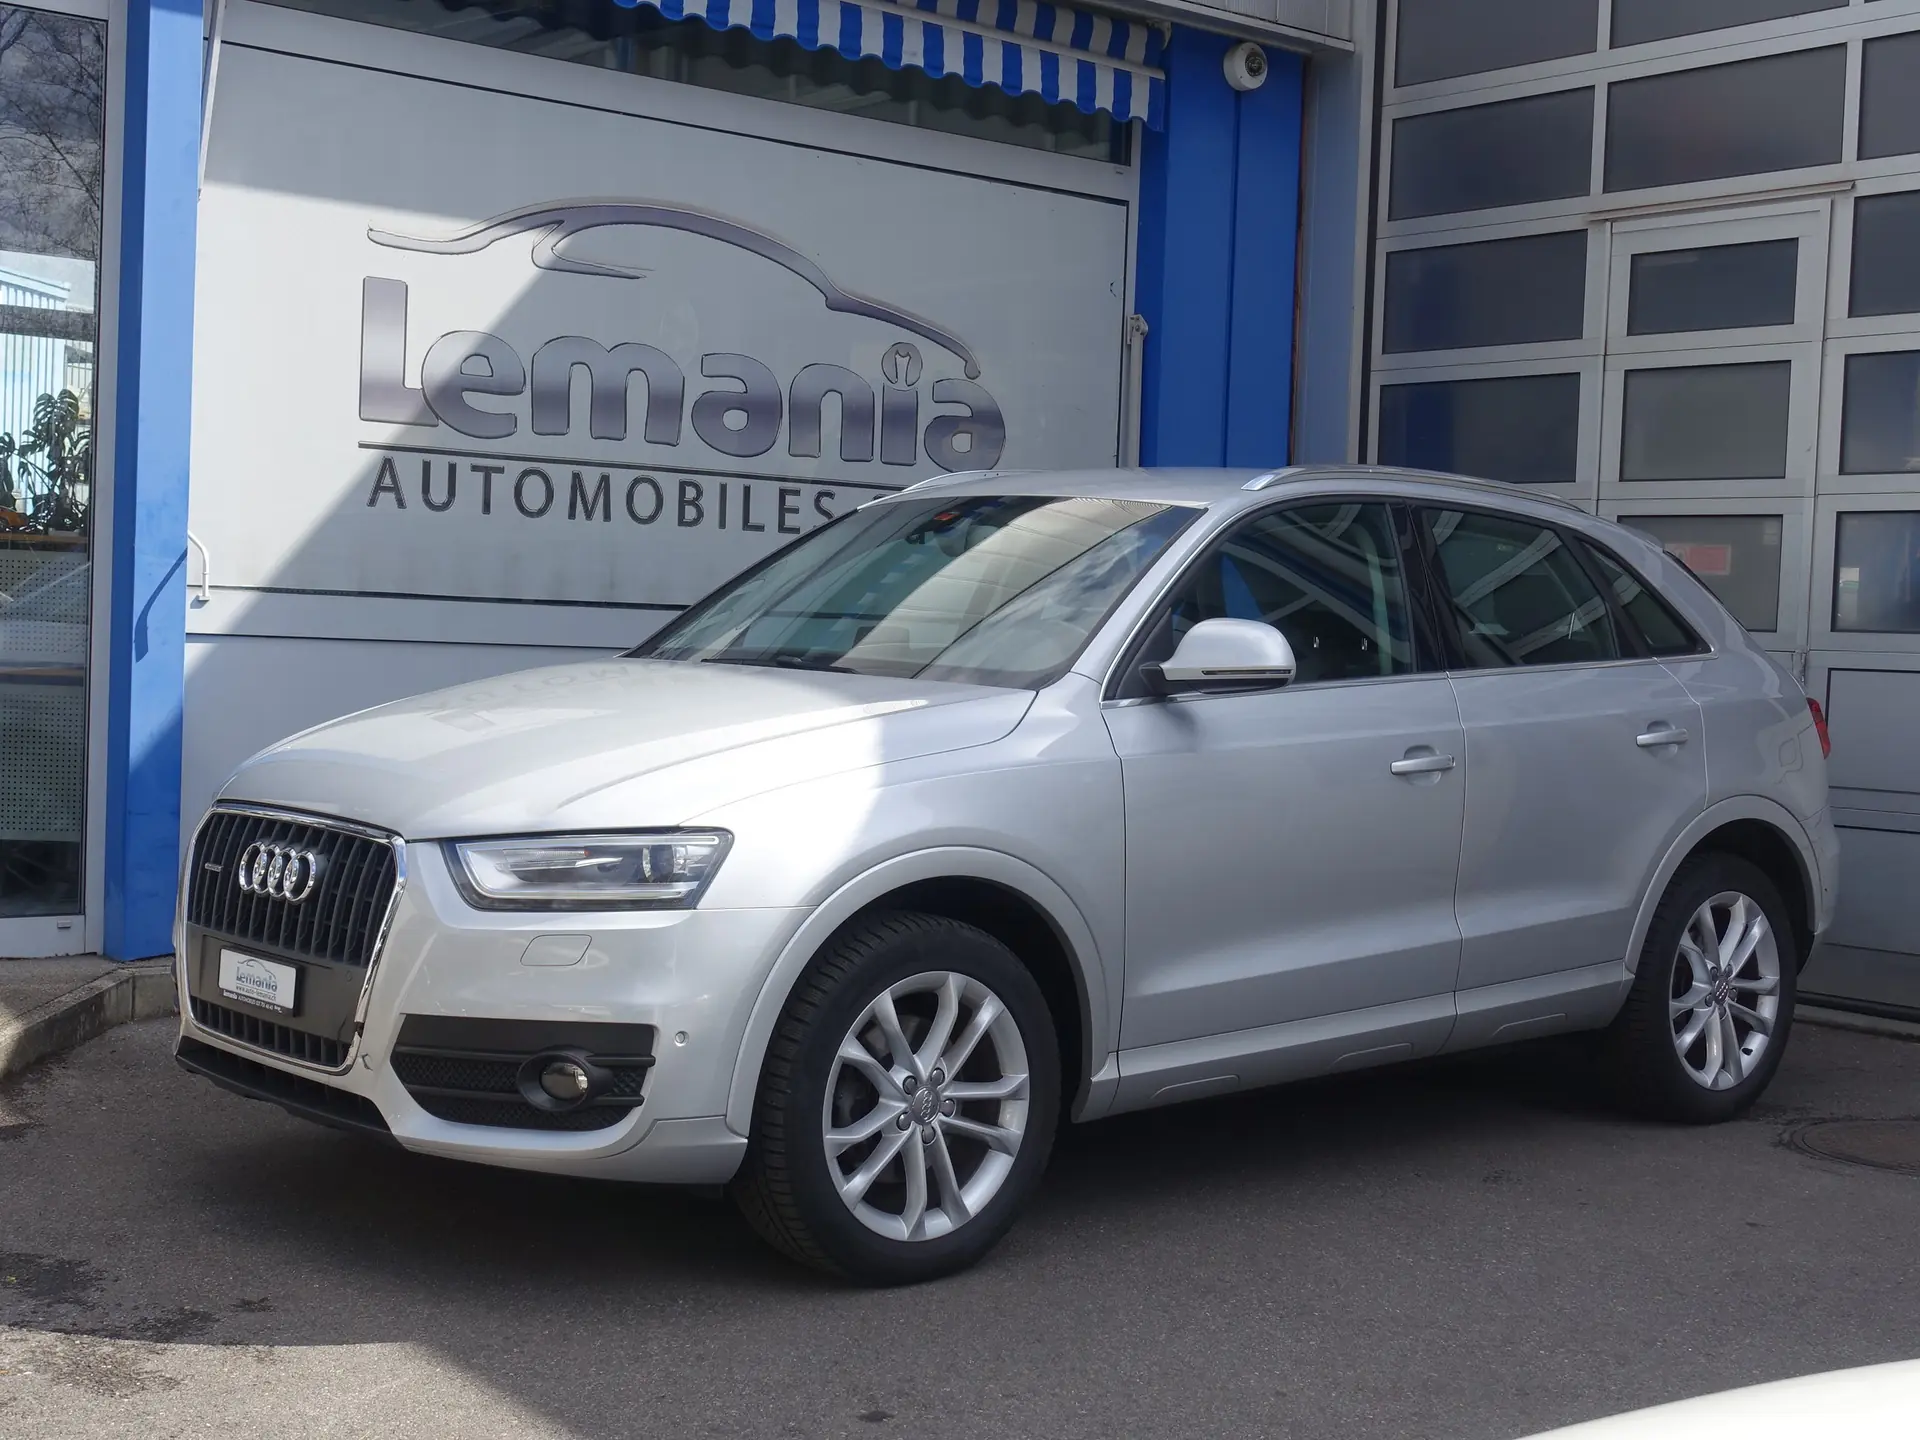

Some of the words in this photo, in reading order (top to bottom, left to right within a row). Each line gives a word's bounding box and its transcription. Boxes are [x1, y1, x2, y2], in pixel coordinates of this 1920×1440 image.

[359, 275, 1006, 472] Lemania
[367, 455, 836, 534] AUTOMOBILES
[236, 966, 278, 992] Lemania
